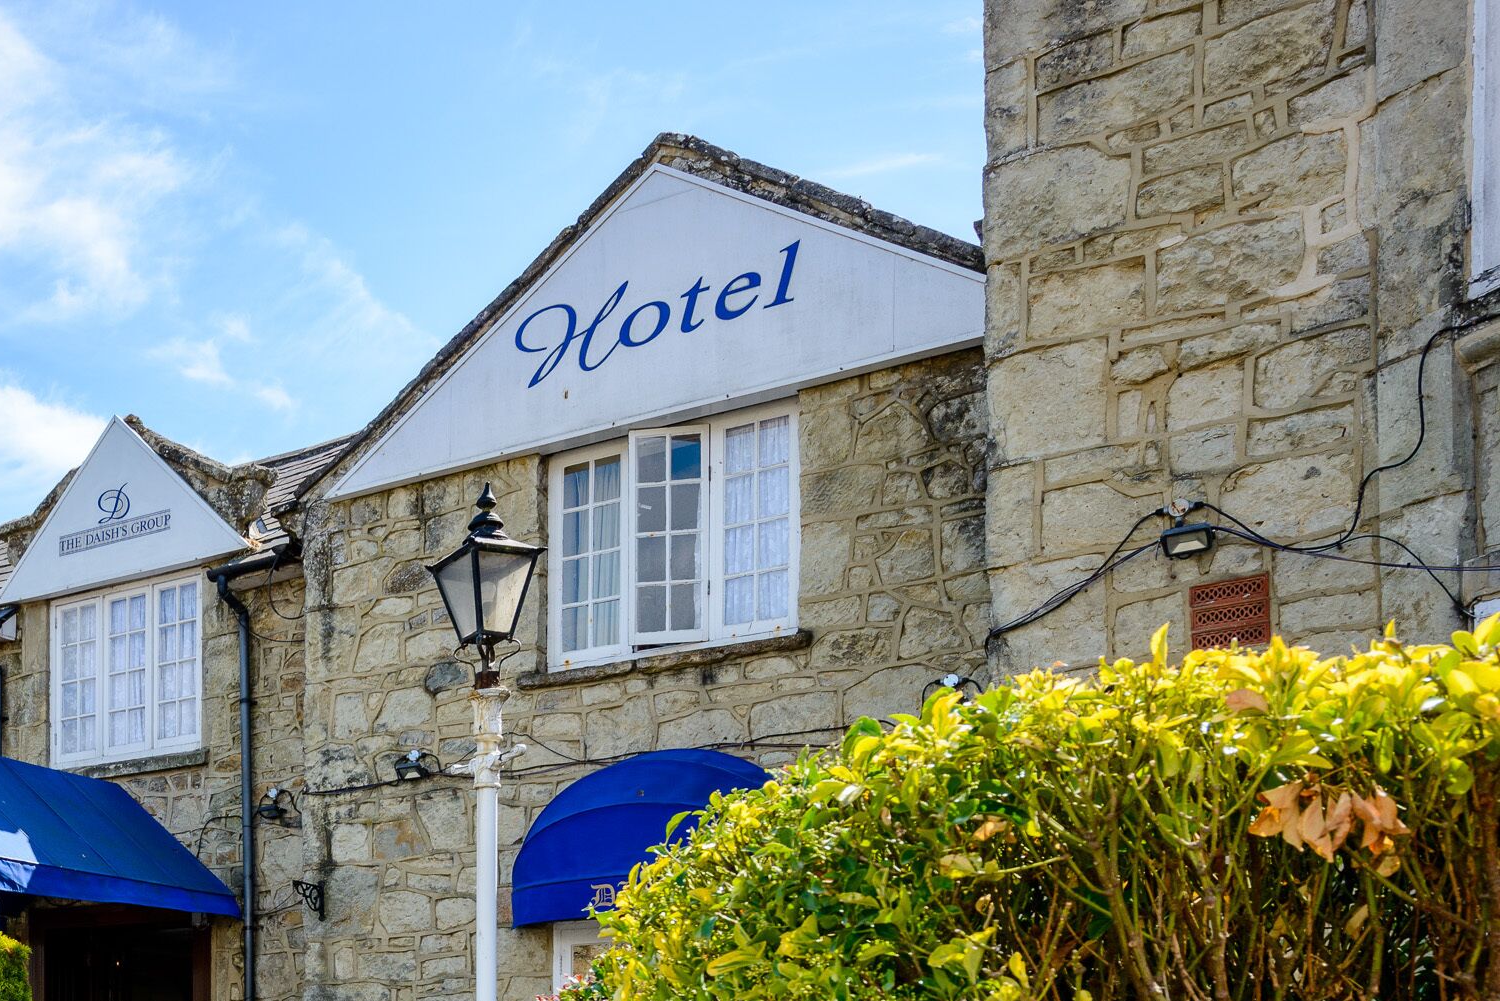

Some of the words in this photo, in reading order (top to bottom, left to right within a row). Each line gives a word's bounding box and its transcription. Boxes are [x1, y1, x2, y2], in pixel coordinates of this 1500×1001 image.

[514, 238, 800, 389] Hotel
[60, 537, 82, 552] THE
[85, 525, 128, 546] DAISH'S
[131, 513, 171, 534] GROUP
